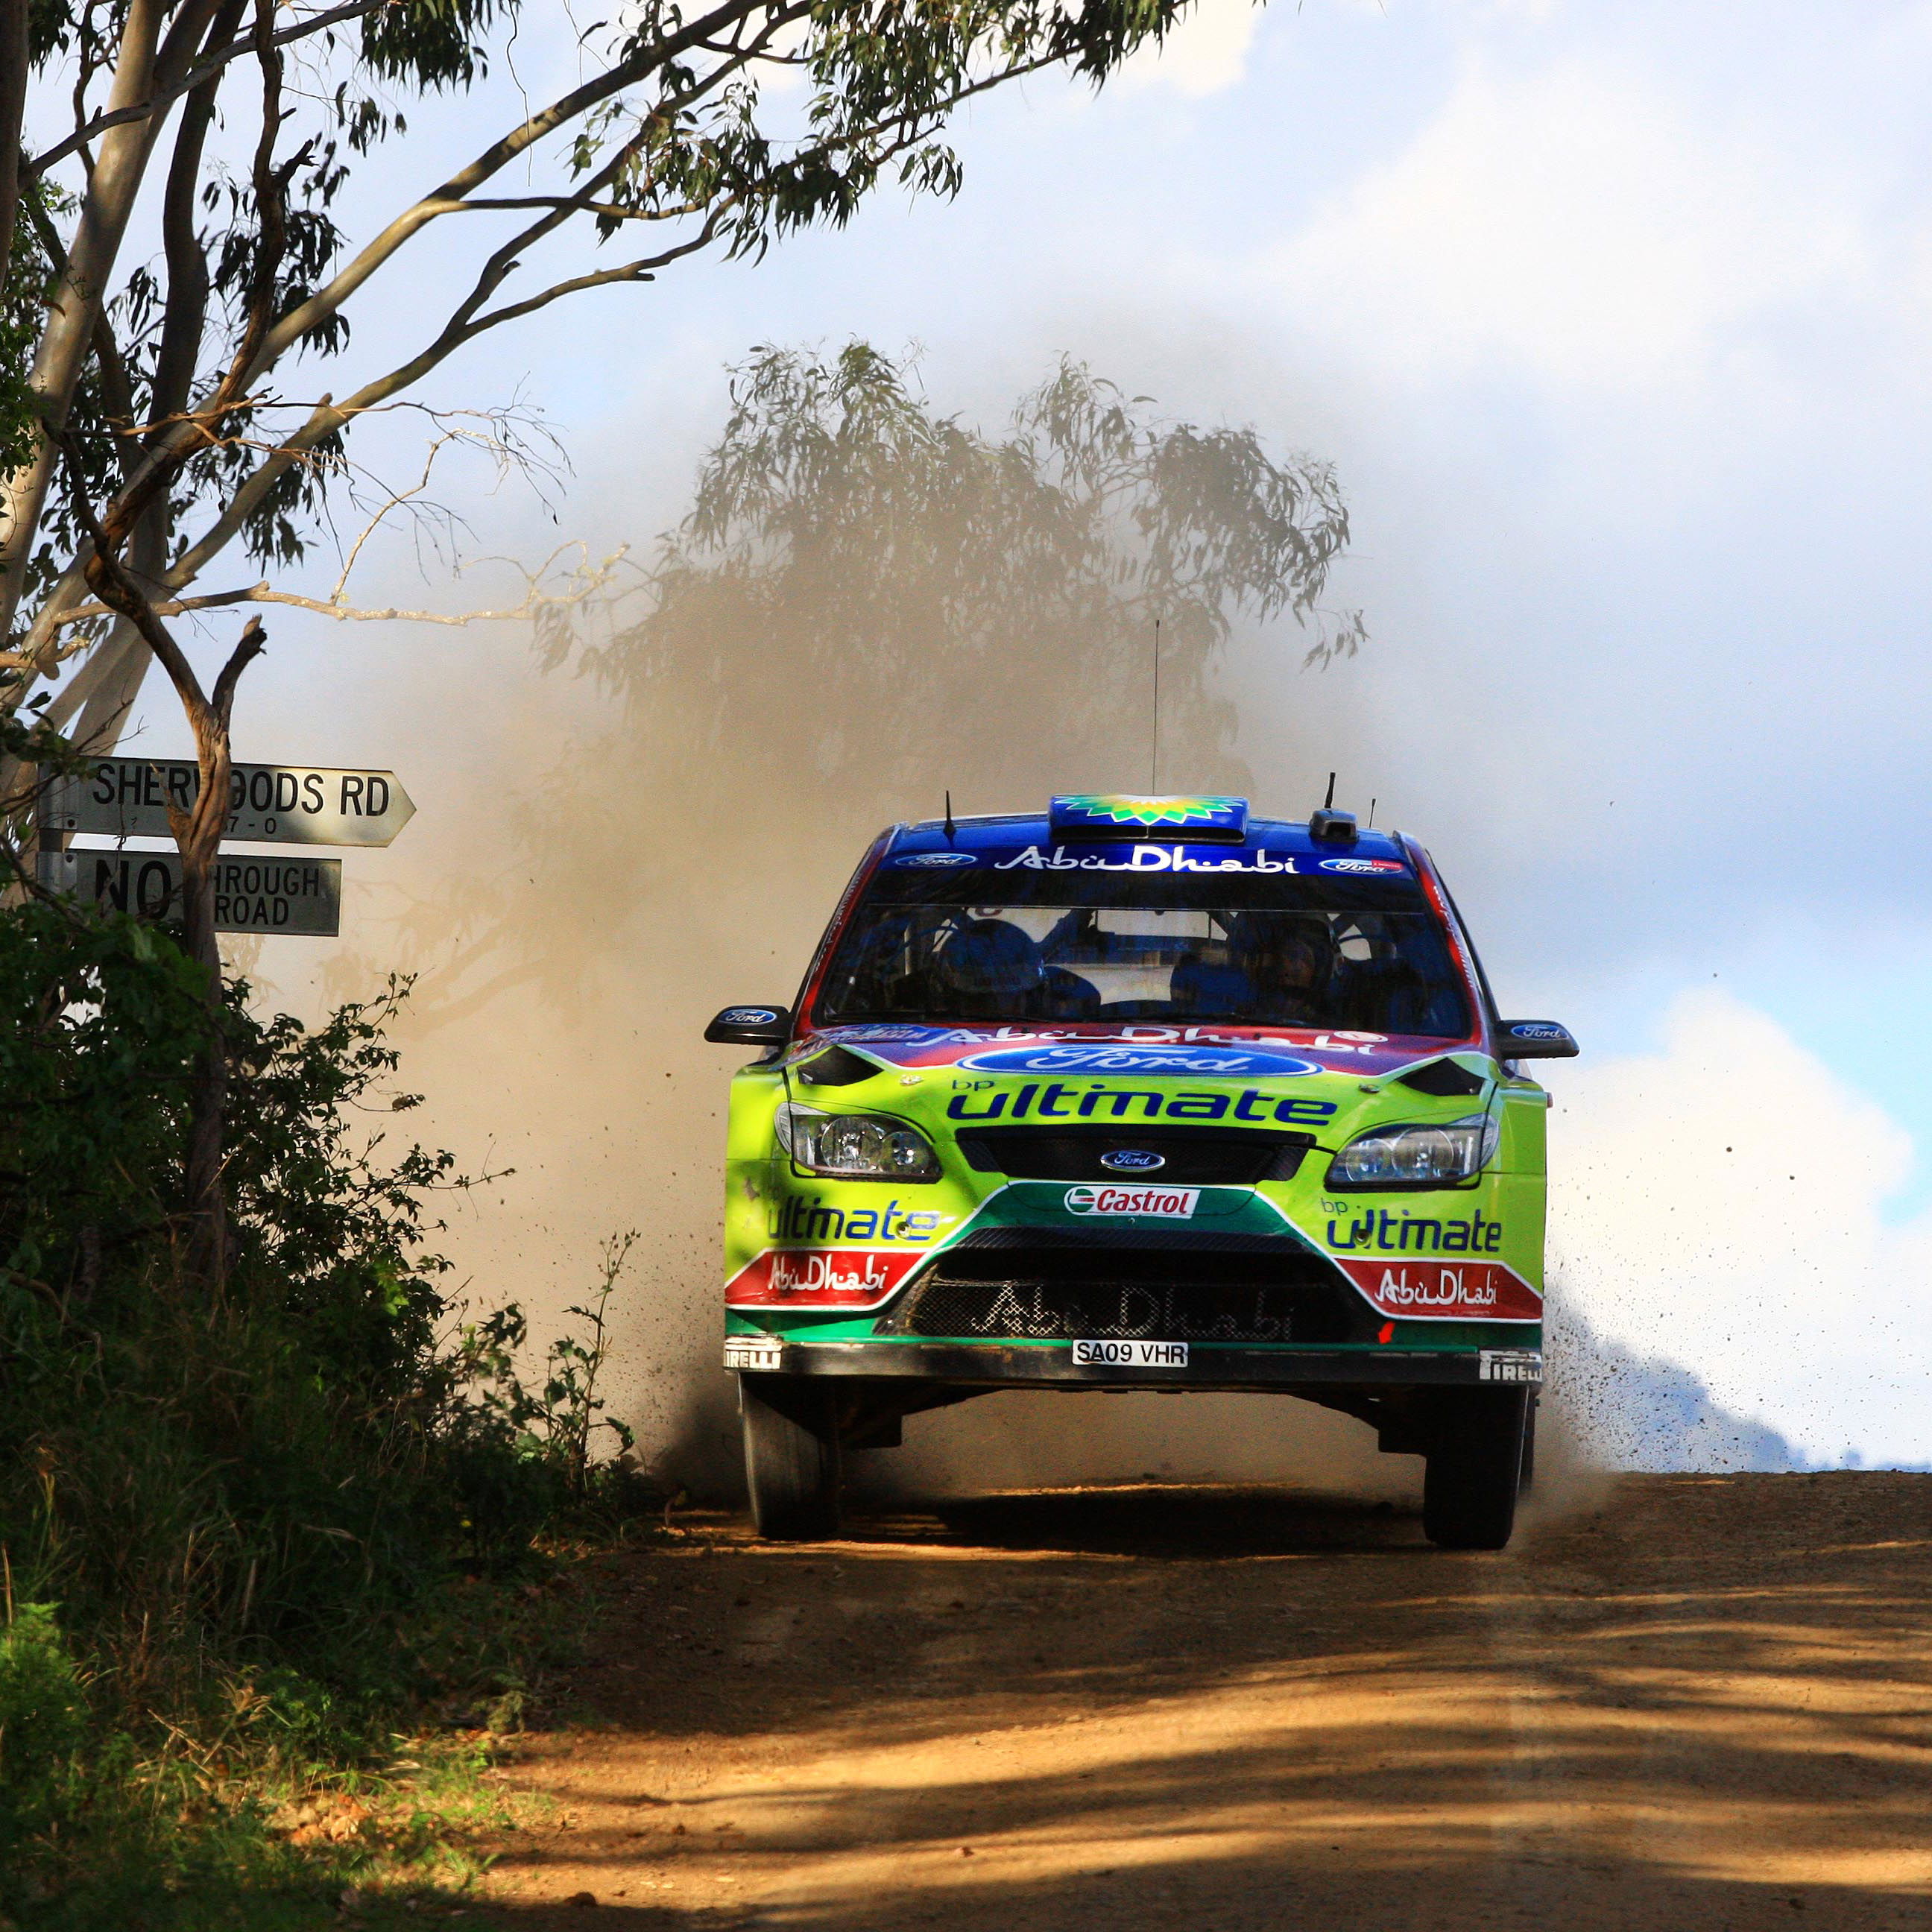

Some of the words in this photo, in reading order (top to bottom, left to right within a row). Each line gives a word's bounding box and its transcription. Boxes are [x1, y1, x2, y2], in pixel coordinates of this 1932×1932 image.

[92, 763, 323, 815] SHEROODS
[340, 775, 390, 818] RD
[907, 854, 965, 866] Ford
[95, 859, 172, 920] NO
[214, 895, 289, 926] ROAD
[724, 1009, 767, 1023] Ford
[1522, 1026, 1562, 1039] Ford
[1024, 1045, 1250, 1073] Ford
[951, 1079, 995, 1092] bp
[946, 1083, 1339, 1126] ultimate
[1114, 1151, 1151, 1166] Ford
[1096, 1189, 1190, 1214] Castrol
[1320, 1197, 1348, 1216] bp
[768, 1196, 941, 1241] ultimate
[1327, 1208, 1502, 1253] ultimate
[1077, 1342, 1132, 1363] SA09
[1140, 1344, 1185, 1365] VHR
